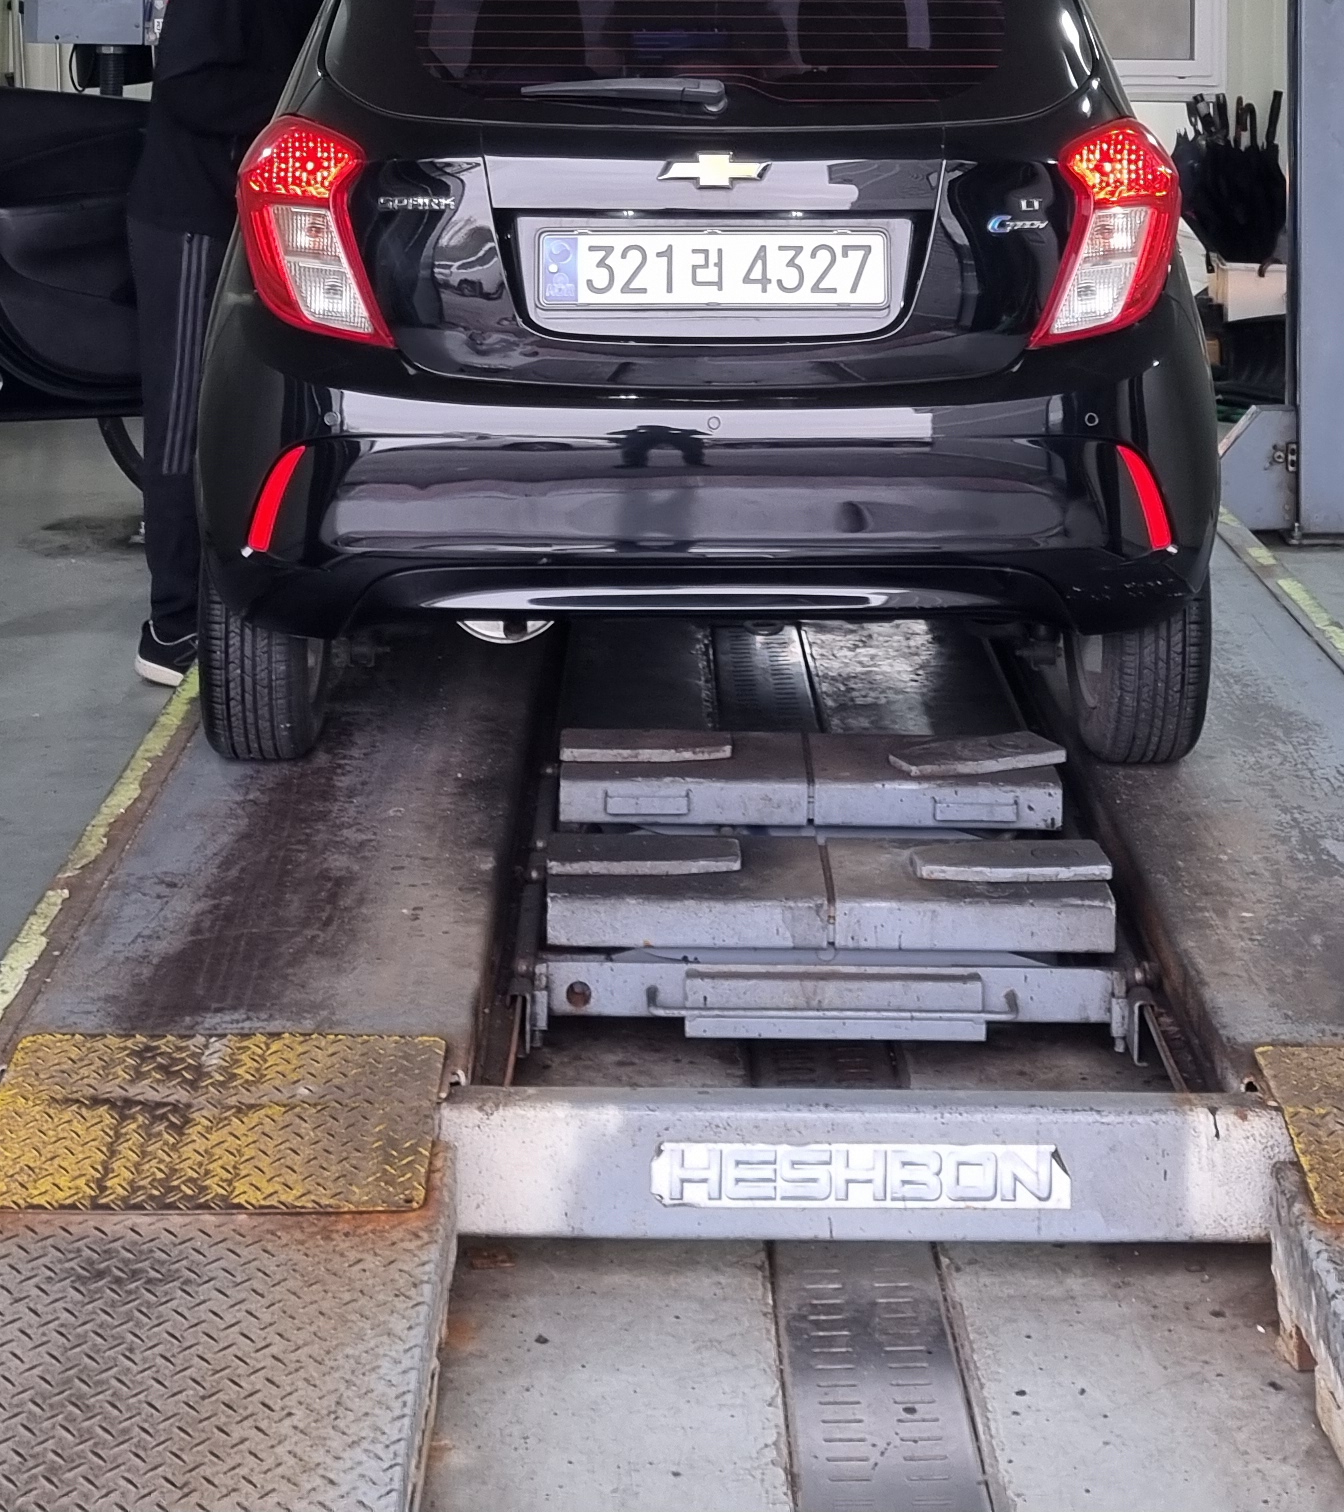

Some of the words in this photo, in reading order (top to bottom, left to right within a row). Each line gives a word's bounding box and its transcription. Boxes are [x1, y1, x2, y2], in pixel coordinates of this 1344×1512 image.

[378, 196, 455, 211] SPARK
[1020, 199, 1043, 210] LT
[742, 244, 872, 294] 4327
[669, 1148, 1053, 1202] HESHBON
